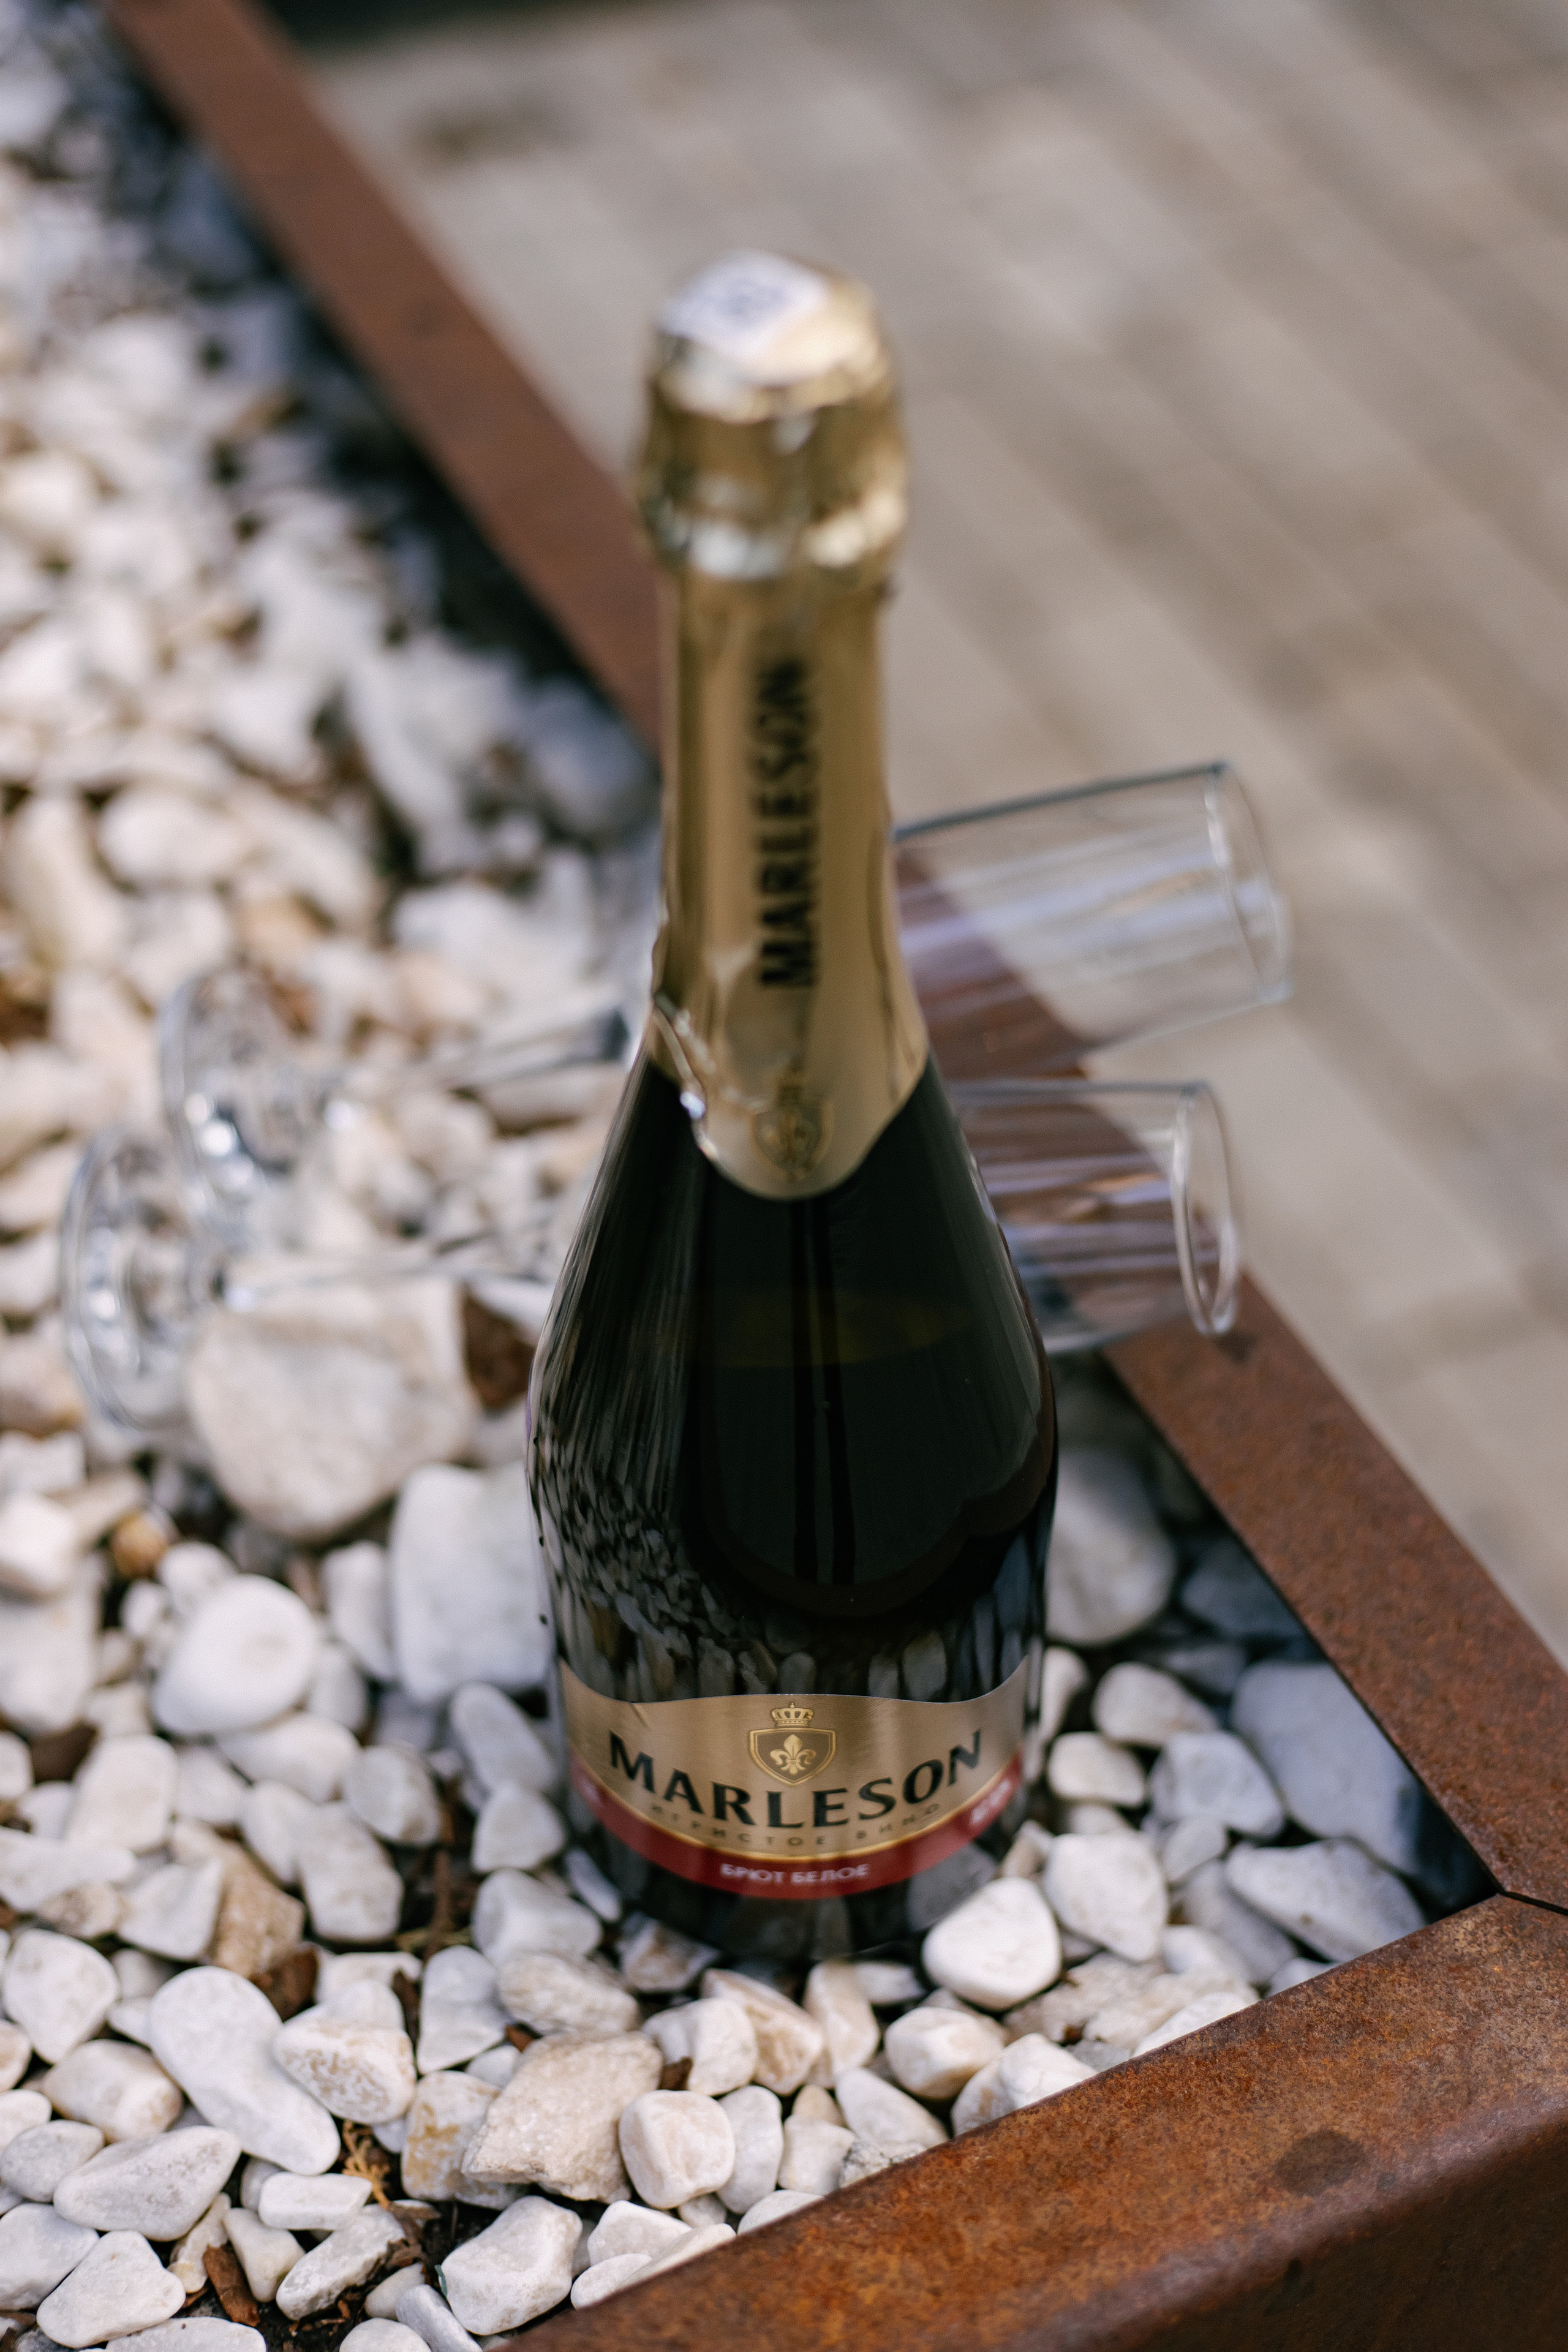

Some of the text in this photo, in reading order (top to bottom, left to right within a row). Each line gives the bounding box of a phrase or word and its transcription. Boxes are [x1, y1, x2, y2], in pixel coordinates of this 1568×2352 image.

[756, 657, 818, 987] MARLESON
[609, 1730, 981, 1828] MARLESON
[720, 1863, 870, 1885] БРЮТ БЕЛОЕ
